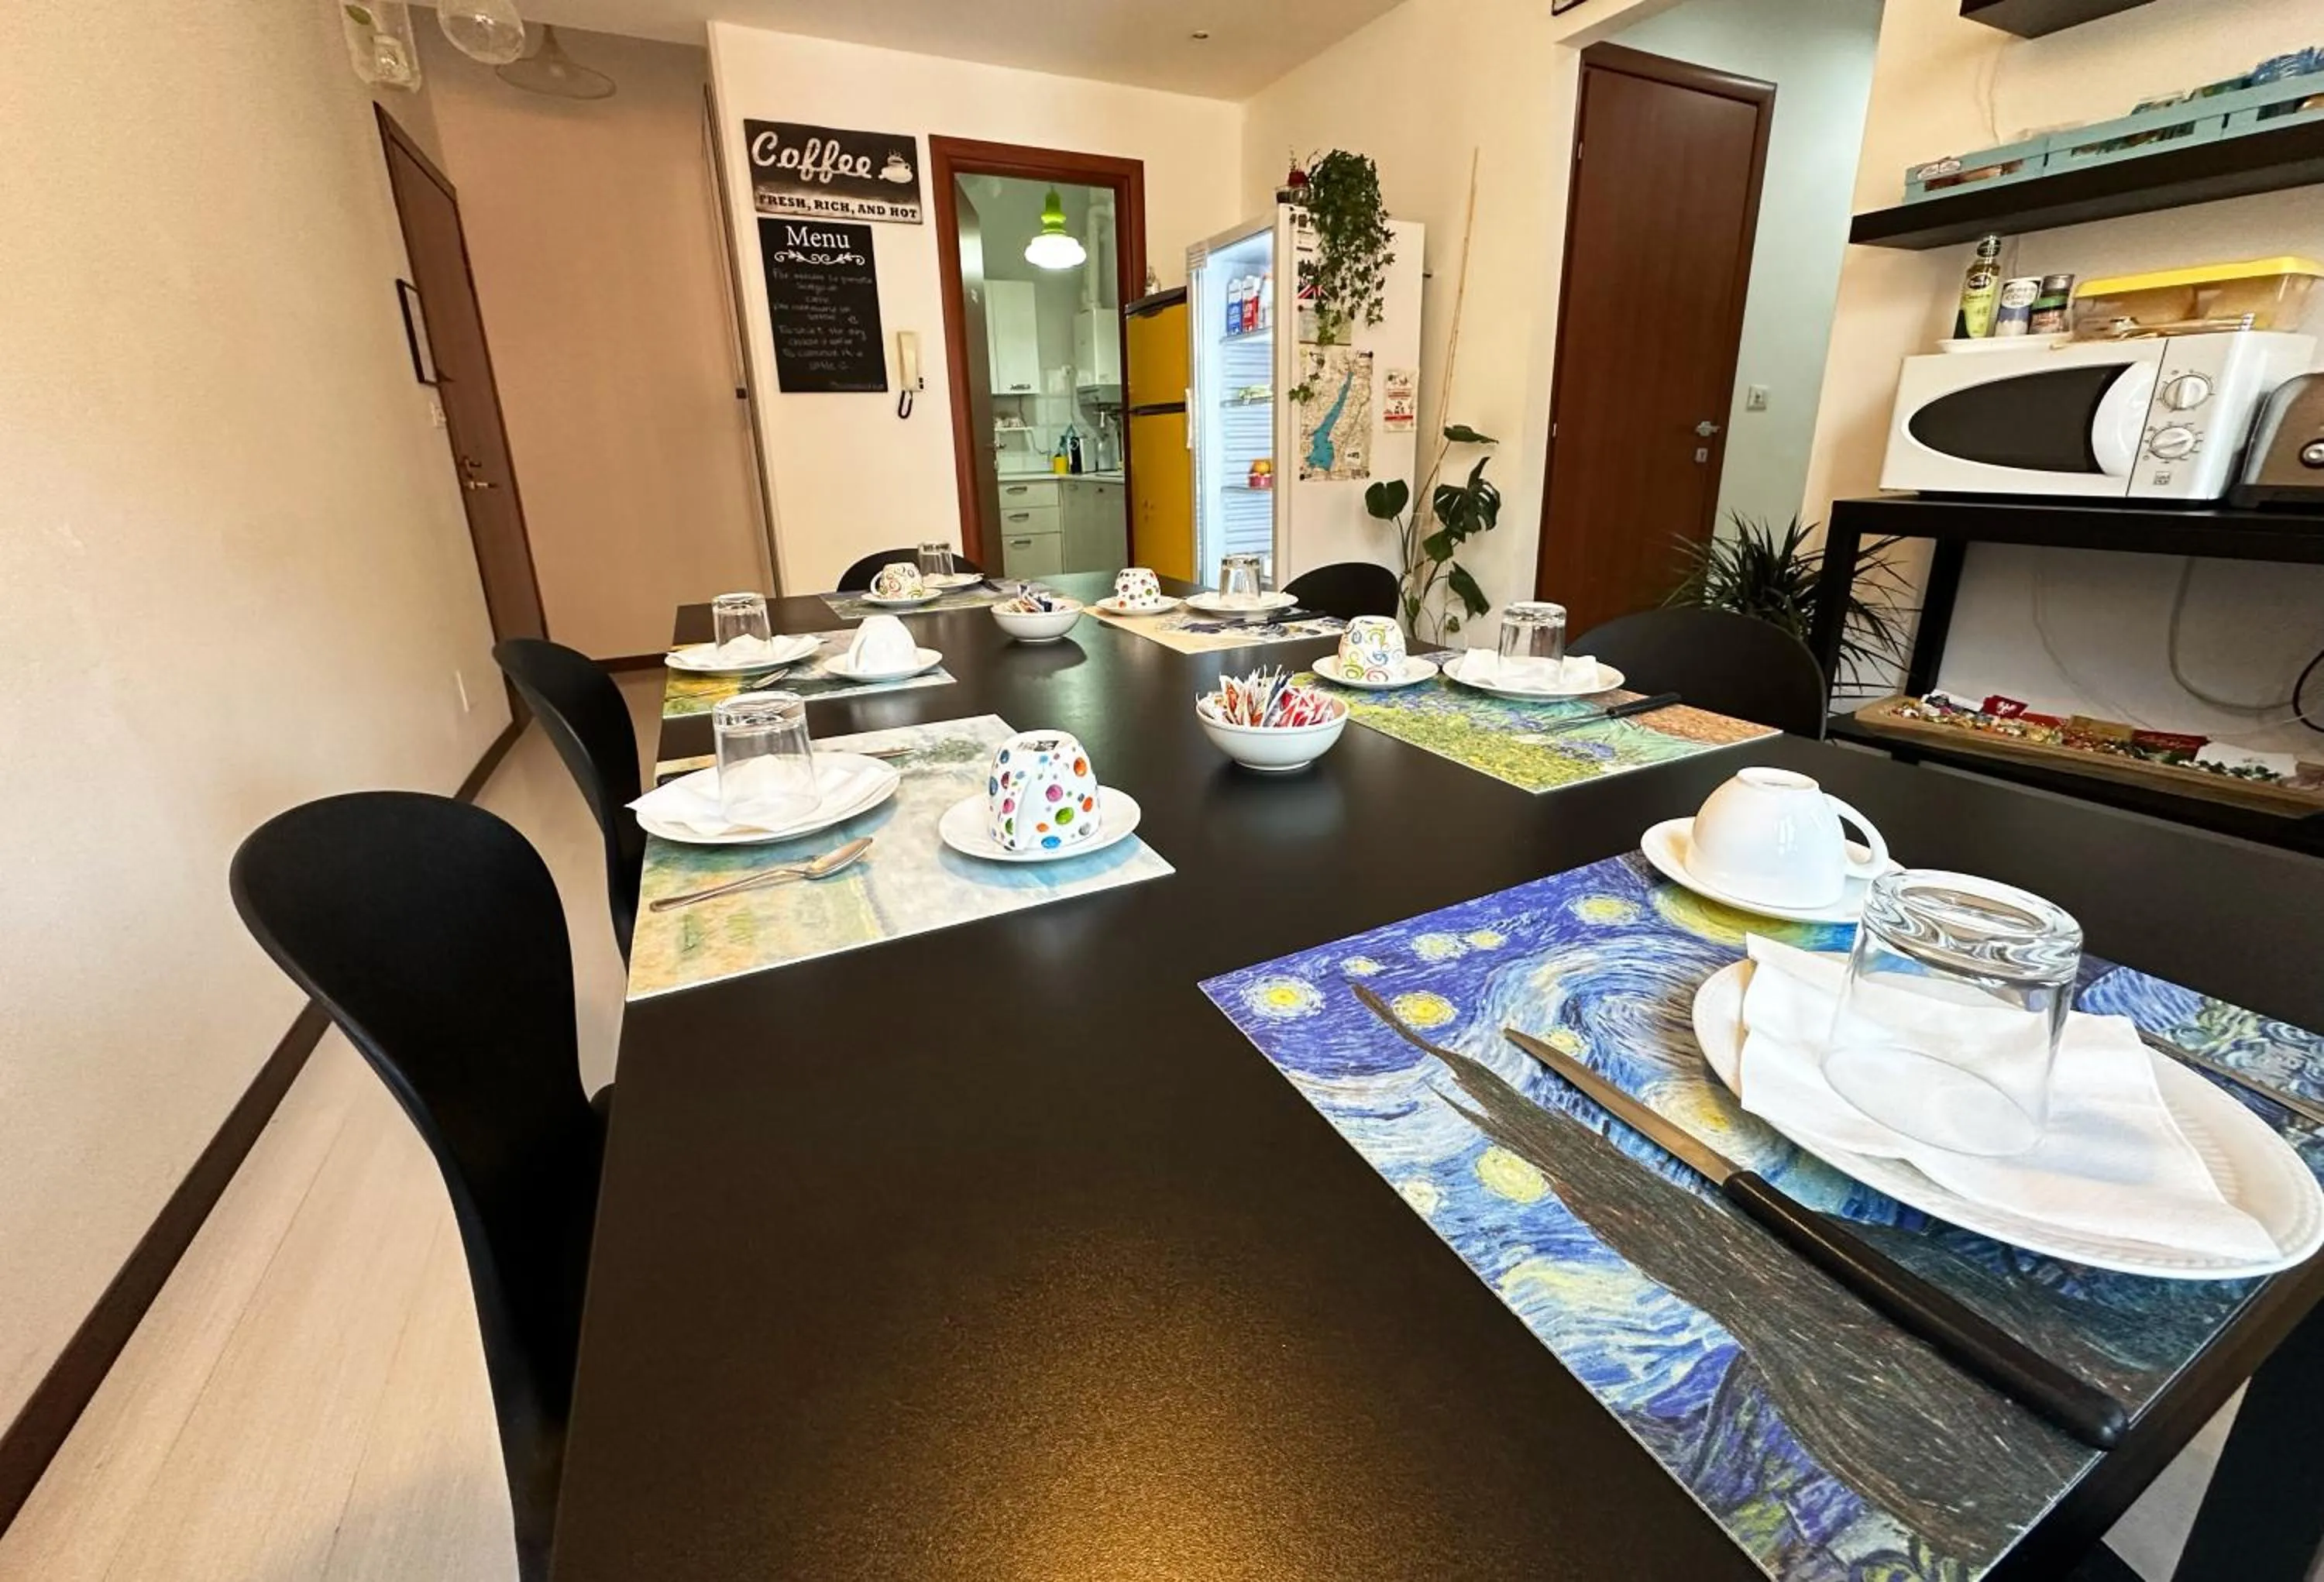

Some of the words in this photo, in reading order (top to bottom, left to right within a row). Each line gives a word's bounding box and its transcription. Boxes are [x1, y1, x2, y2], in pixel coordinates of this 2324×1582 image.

[751, 131, 872, 184] Coffee
[758, 194, 812, 211] FRESH,
[814, 198, 855, 215] RICH,
[858, 204, 885, 215] AND
[890, 207, 918, 218] HOT
[786, 225, 851, 249] Menu
